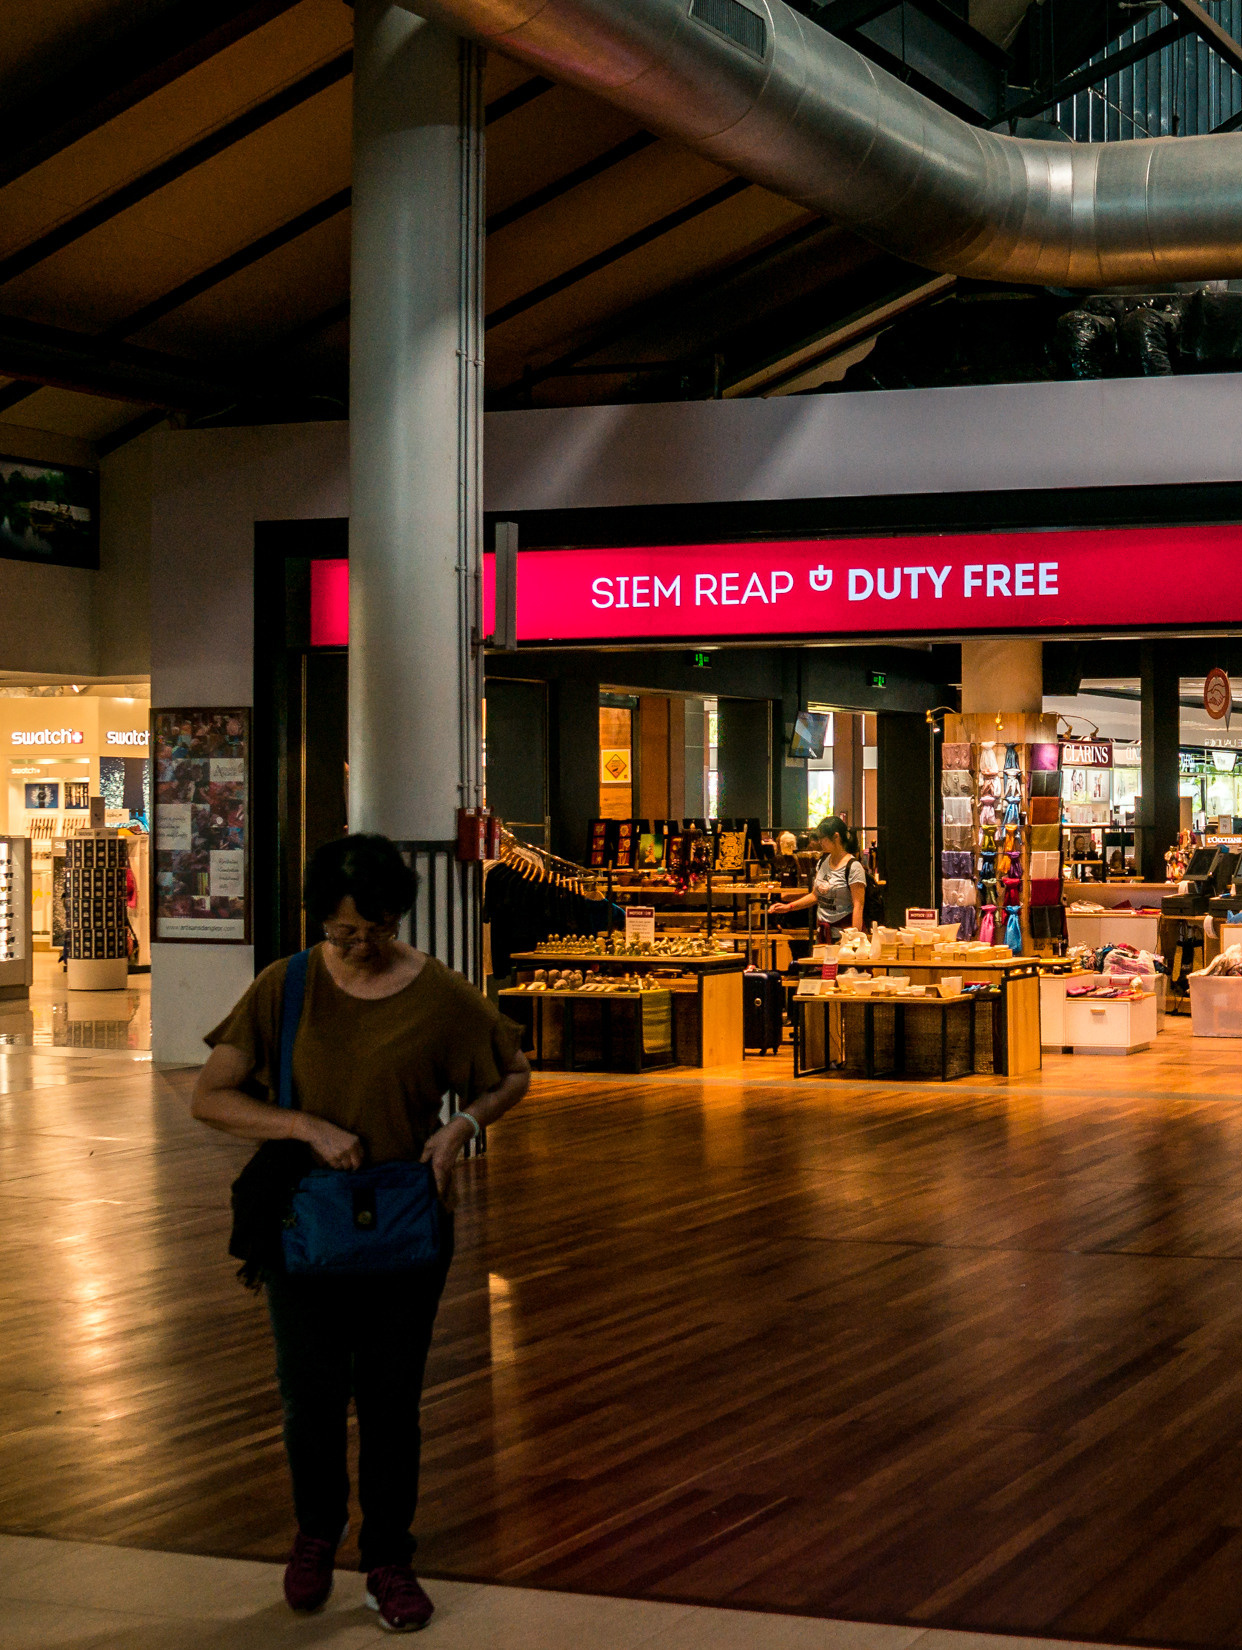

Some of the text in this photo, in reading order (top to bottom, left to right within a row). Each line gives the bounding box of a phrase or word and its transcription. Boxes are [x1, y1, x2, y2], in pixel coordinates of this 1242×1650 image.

[592, 562, 1059, 609] SIEM REAP DUTY FREE
[11, 728, 73, 744] swatch
[1063, 743, 1109, 764] CLARINS
